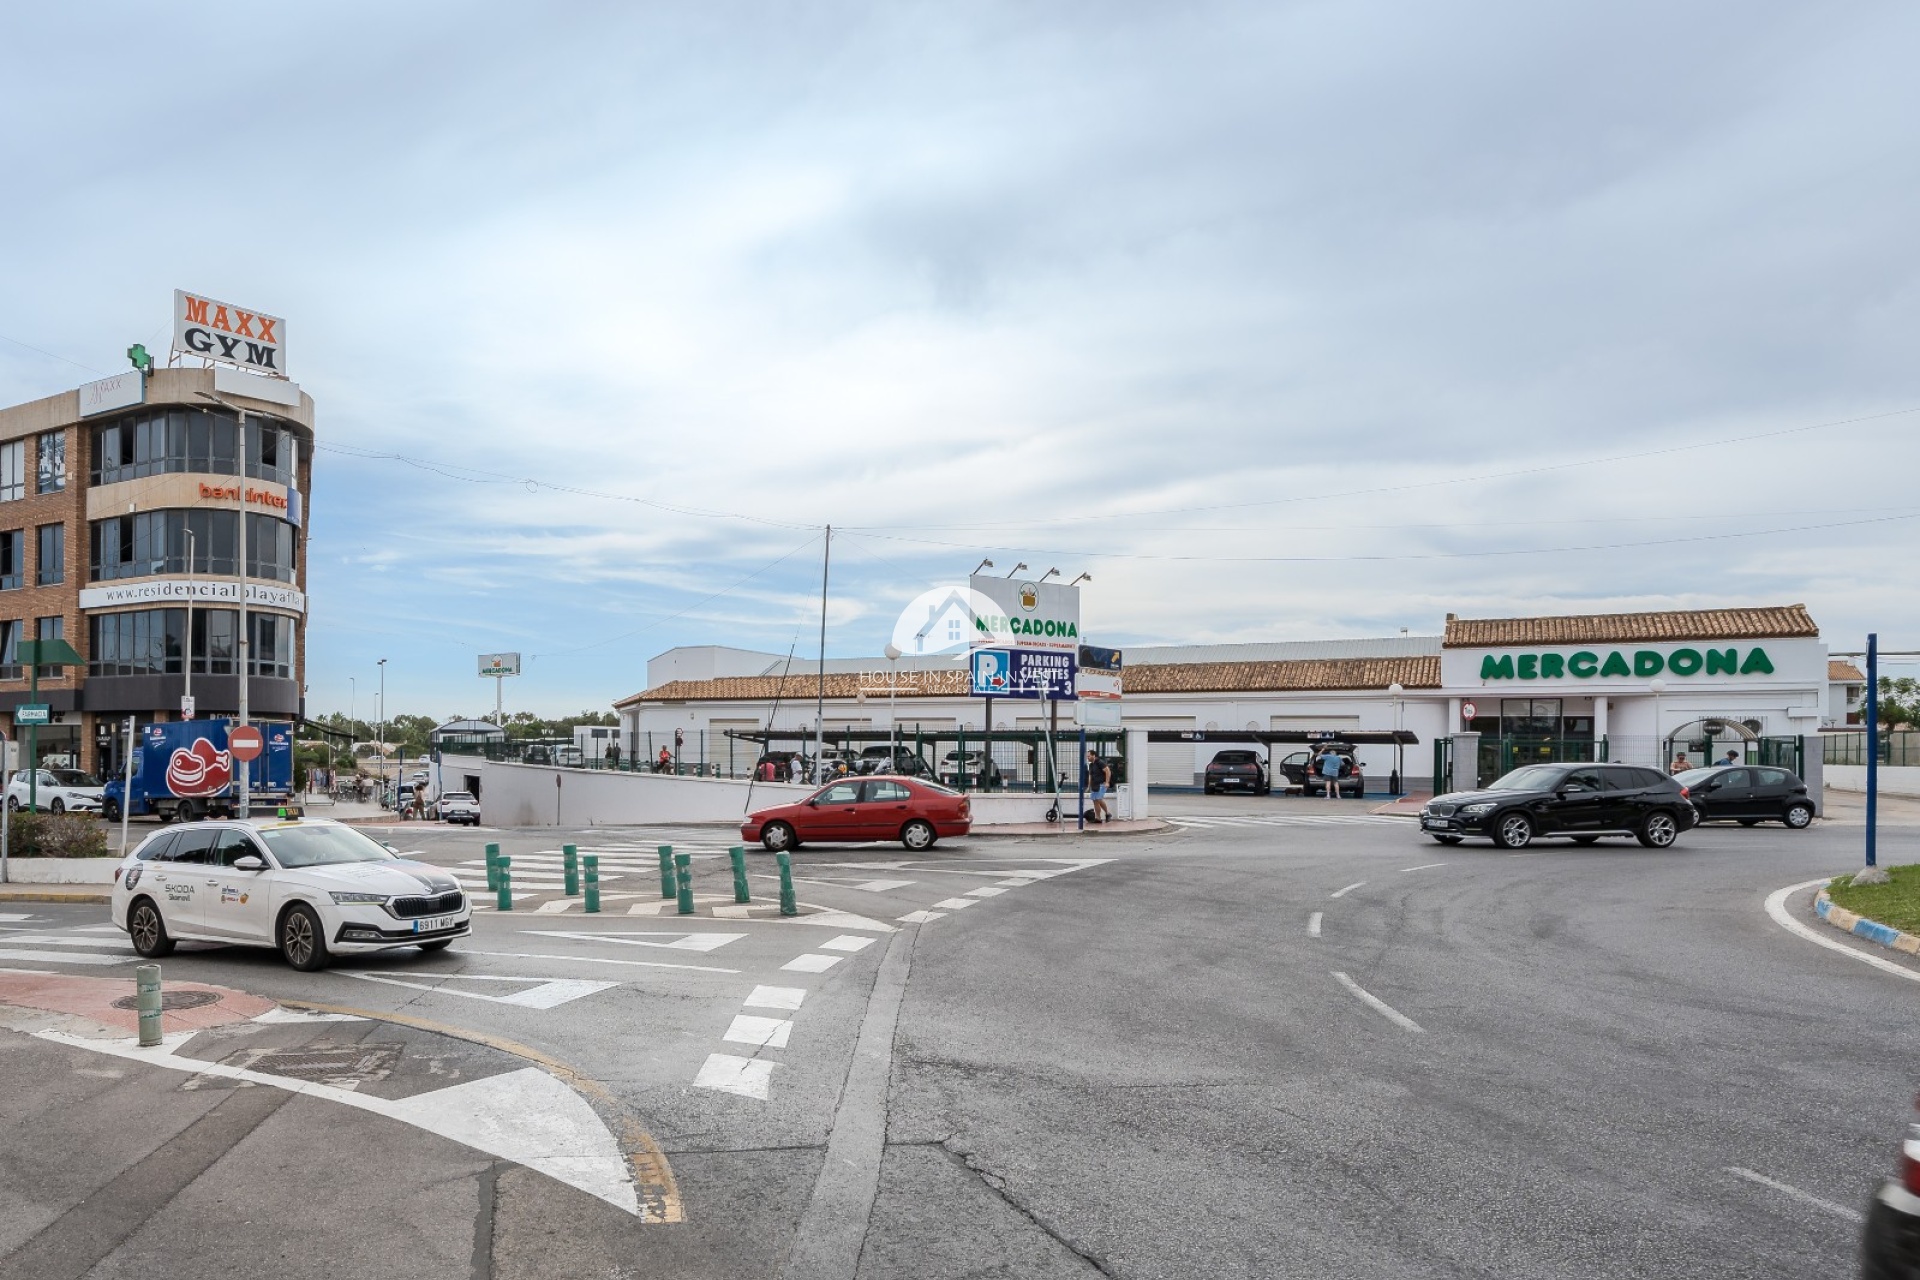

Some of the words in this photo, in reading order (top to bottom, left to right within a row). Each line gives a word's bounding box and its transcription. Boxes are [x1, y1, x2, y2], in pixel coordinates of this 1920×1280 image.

[184, 295, 277, 345] MAXX
[184, 327, 278, 370] GYM
[975, 613, 1078, 638] MERCADONA
[1021, 654, 1070, 668] PARKING
[1480, 647, 1775, 680] MERCADONA
[420, 919, 438, 931] 6911
